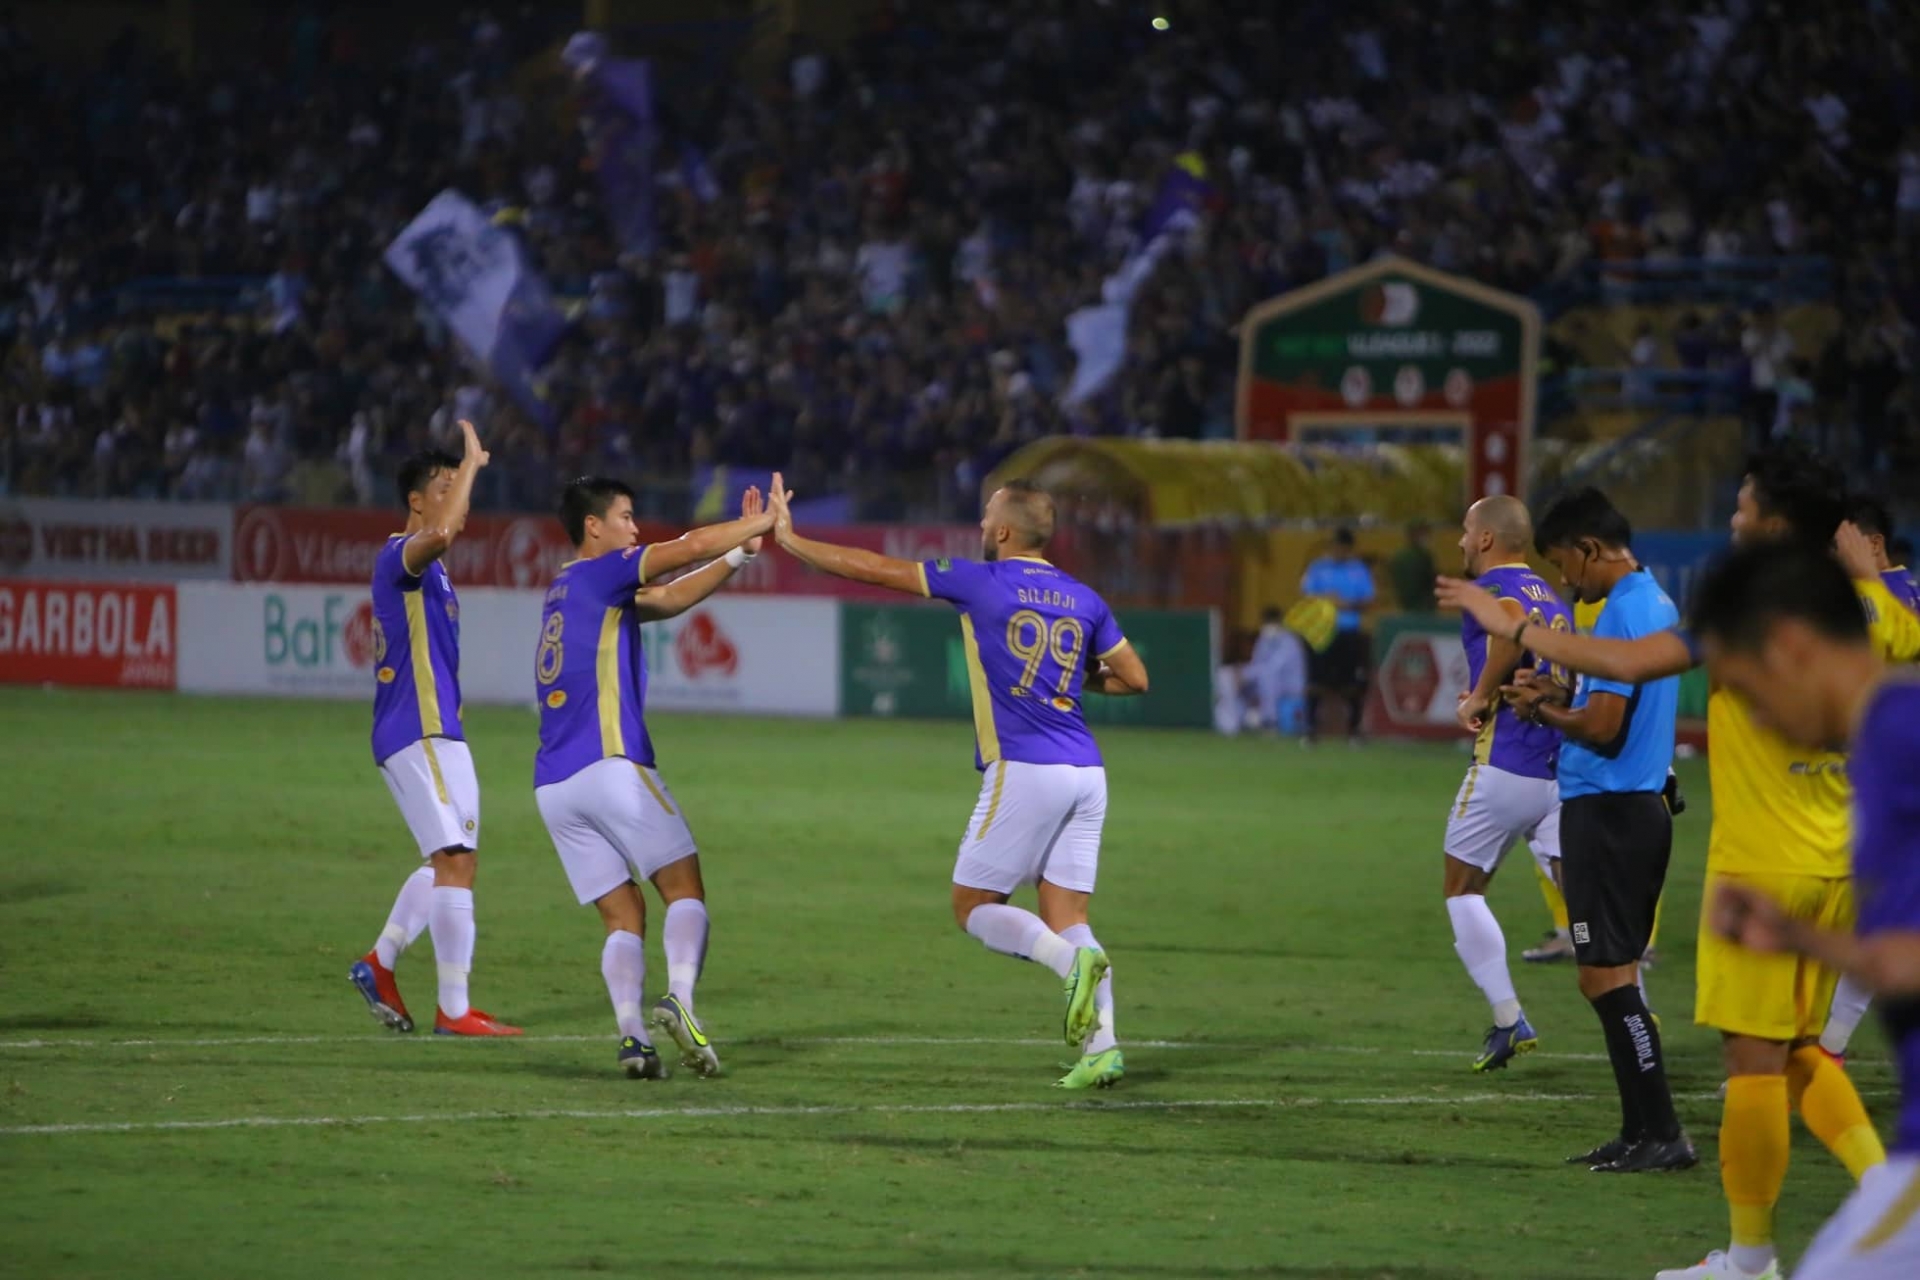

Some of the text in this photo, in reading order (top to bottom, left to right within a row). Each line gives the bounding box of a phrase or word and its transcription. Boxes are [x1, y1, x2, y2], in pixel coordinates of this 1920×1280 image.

[1017, 588, 1075, 610] SILADJI
[1006, 609, 1083, 693] 99
[1624, 1014, 1655, 1072] JOGARBOLA
